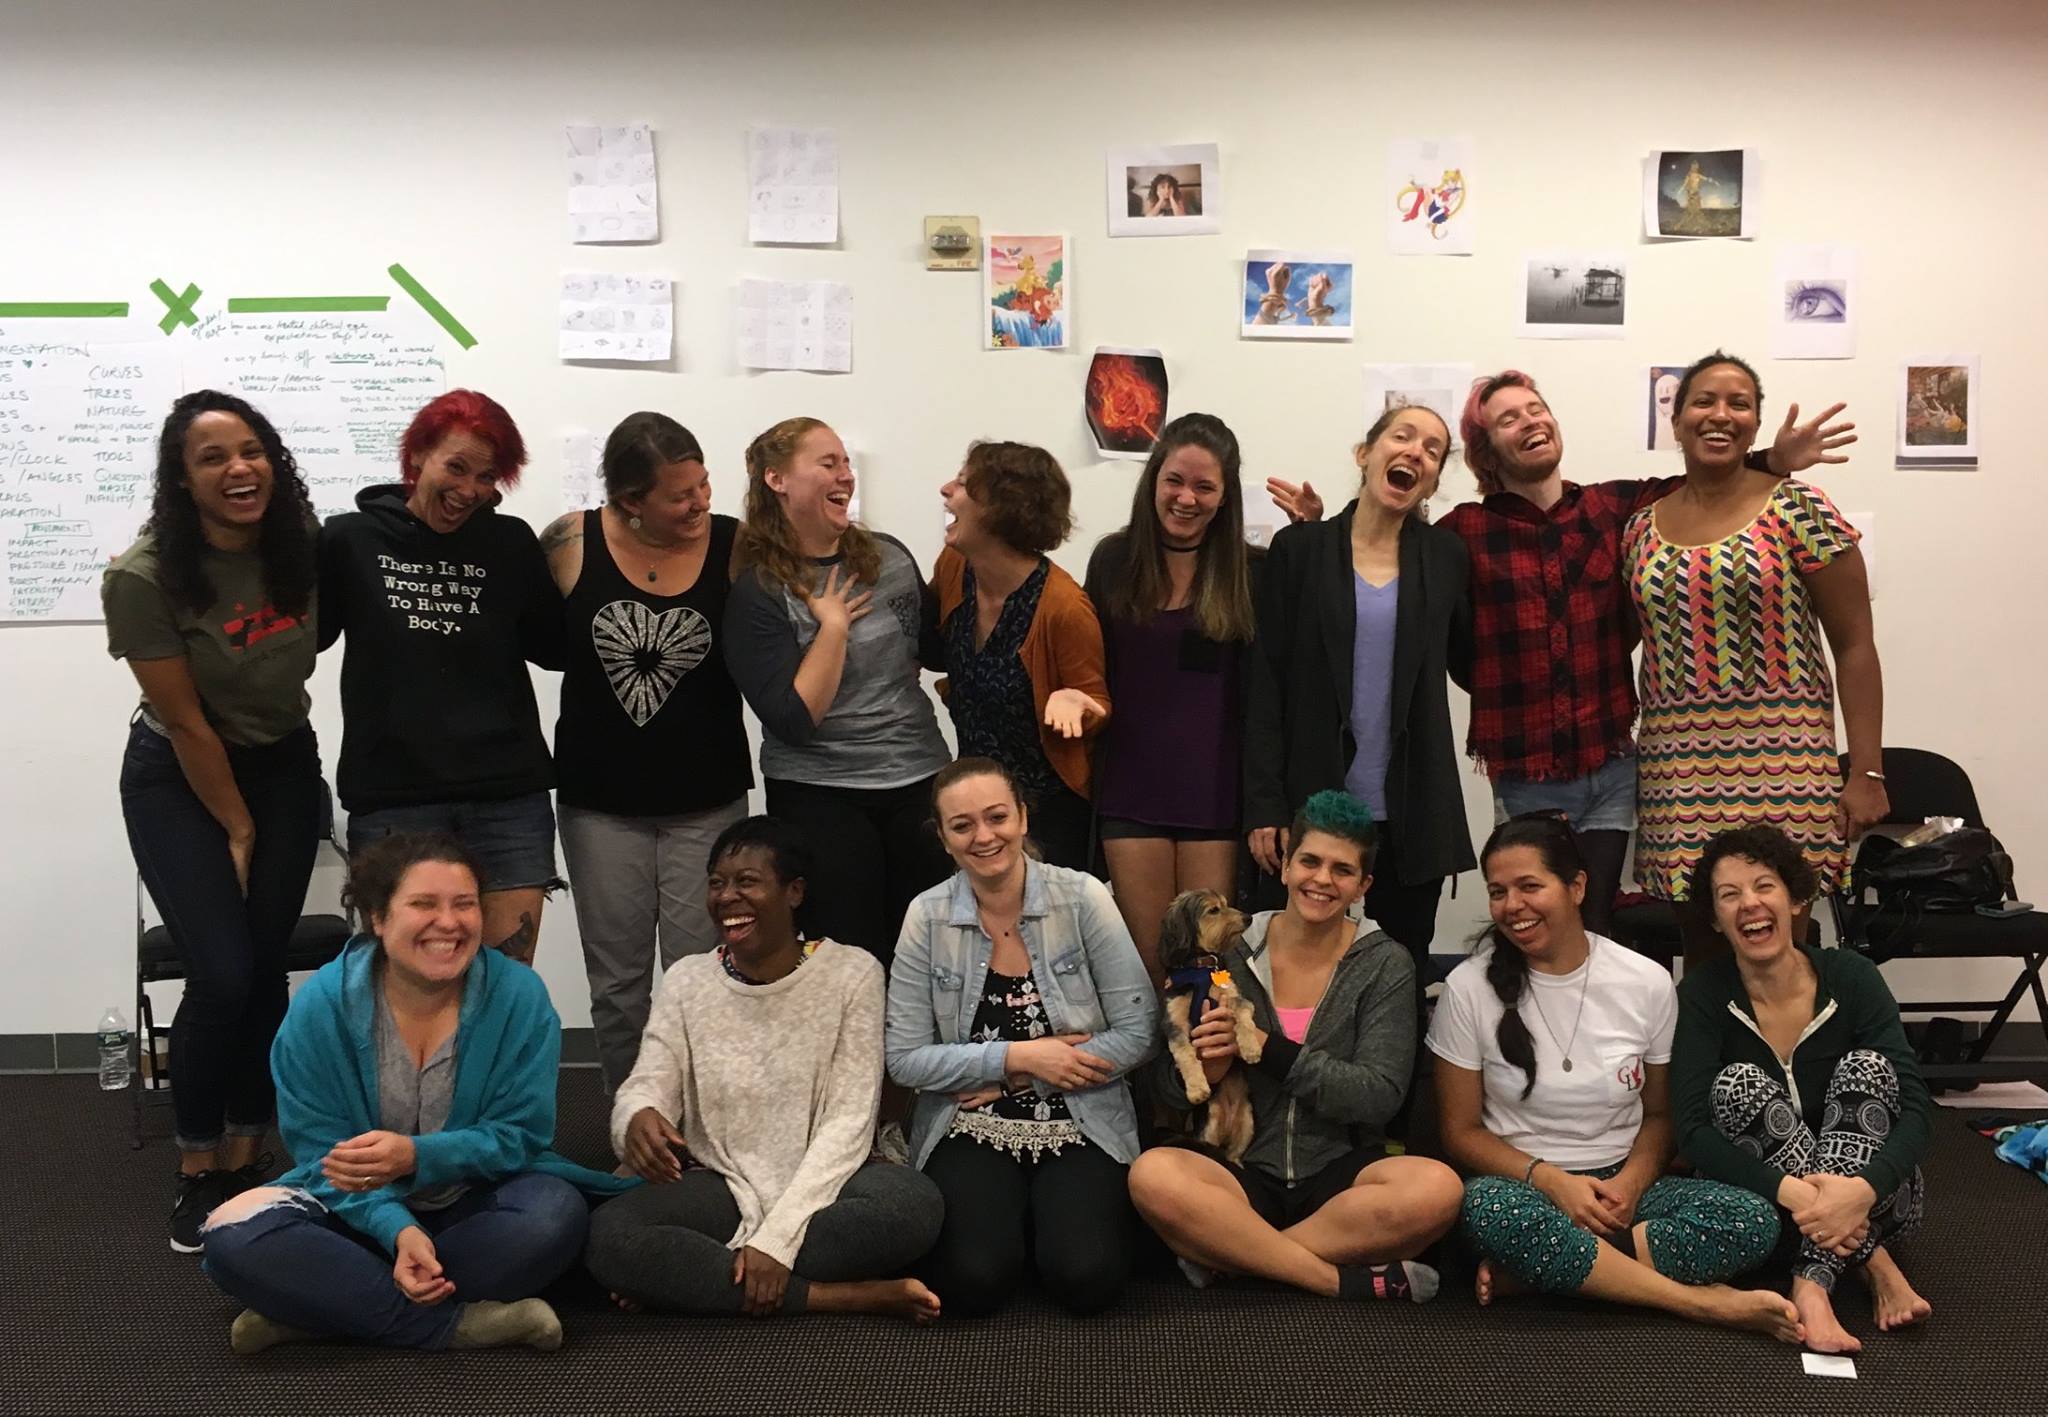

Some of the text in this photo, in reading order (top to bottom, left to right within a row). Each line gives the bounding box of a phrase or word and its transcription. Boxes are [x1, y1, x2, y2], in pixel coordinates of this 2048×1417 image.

[377, 554, 487, 578] There Is No
[383, 575, 483, 599] Wrong Way
[387, 594, 481, 614] To Have A
[407, 615, 462, 635] Body.
